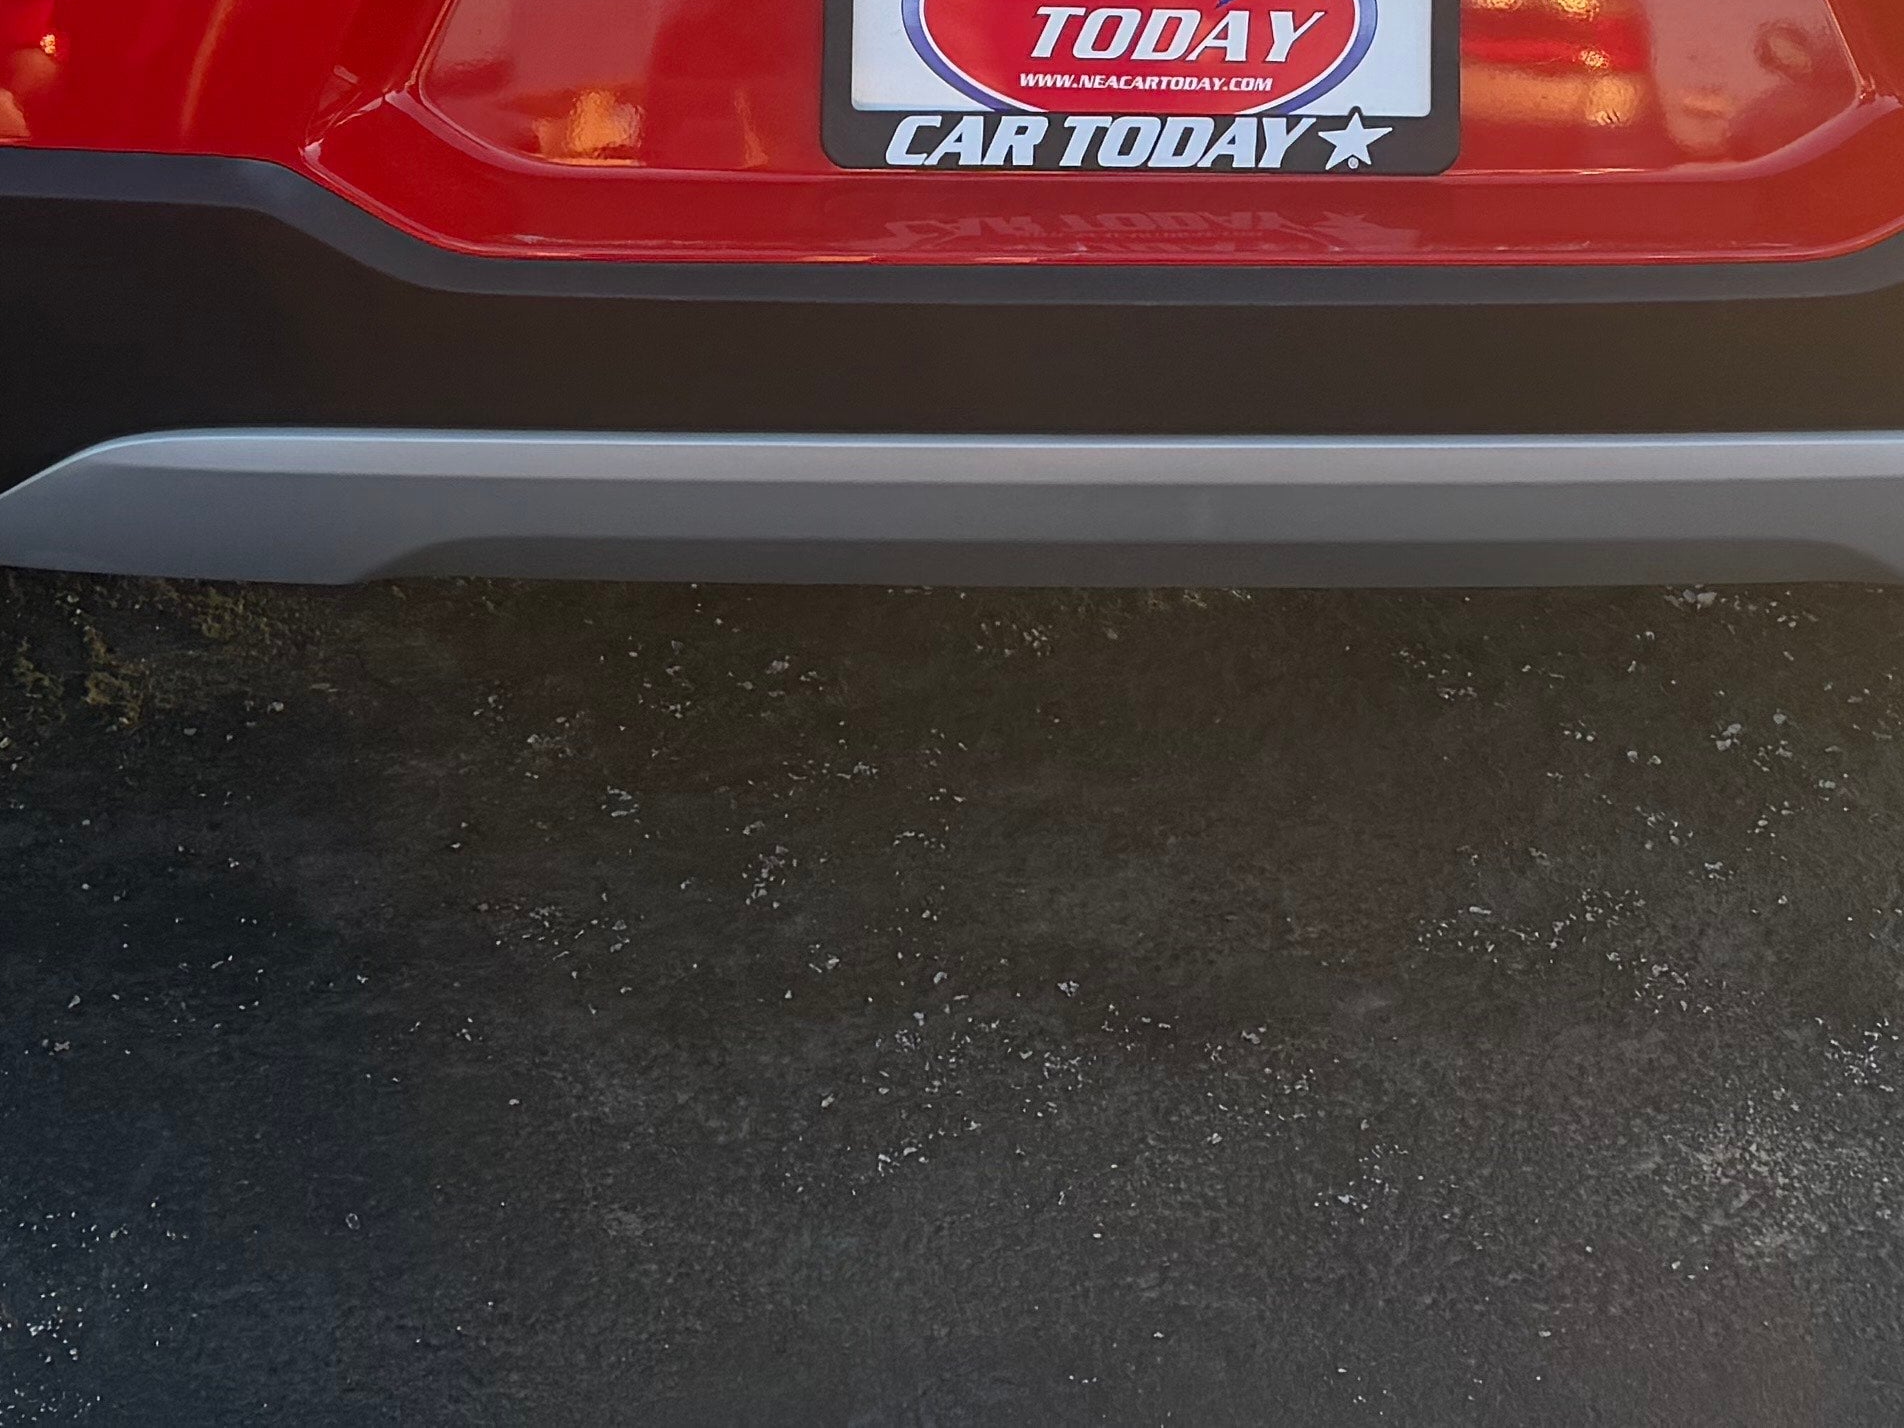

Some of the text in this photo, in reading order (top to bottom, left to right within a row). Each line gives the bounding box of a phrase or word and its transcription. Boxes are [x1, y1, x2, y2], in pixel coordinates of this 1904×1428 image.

[1030, 6, 1327, 63] TODAY
[1019, 72, 1273, 92] WWW.NEACARTODAY.COM
[884, 114, 1317, 170] CAR TODAY
